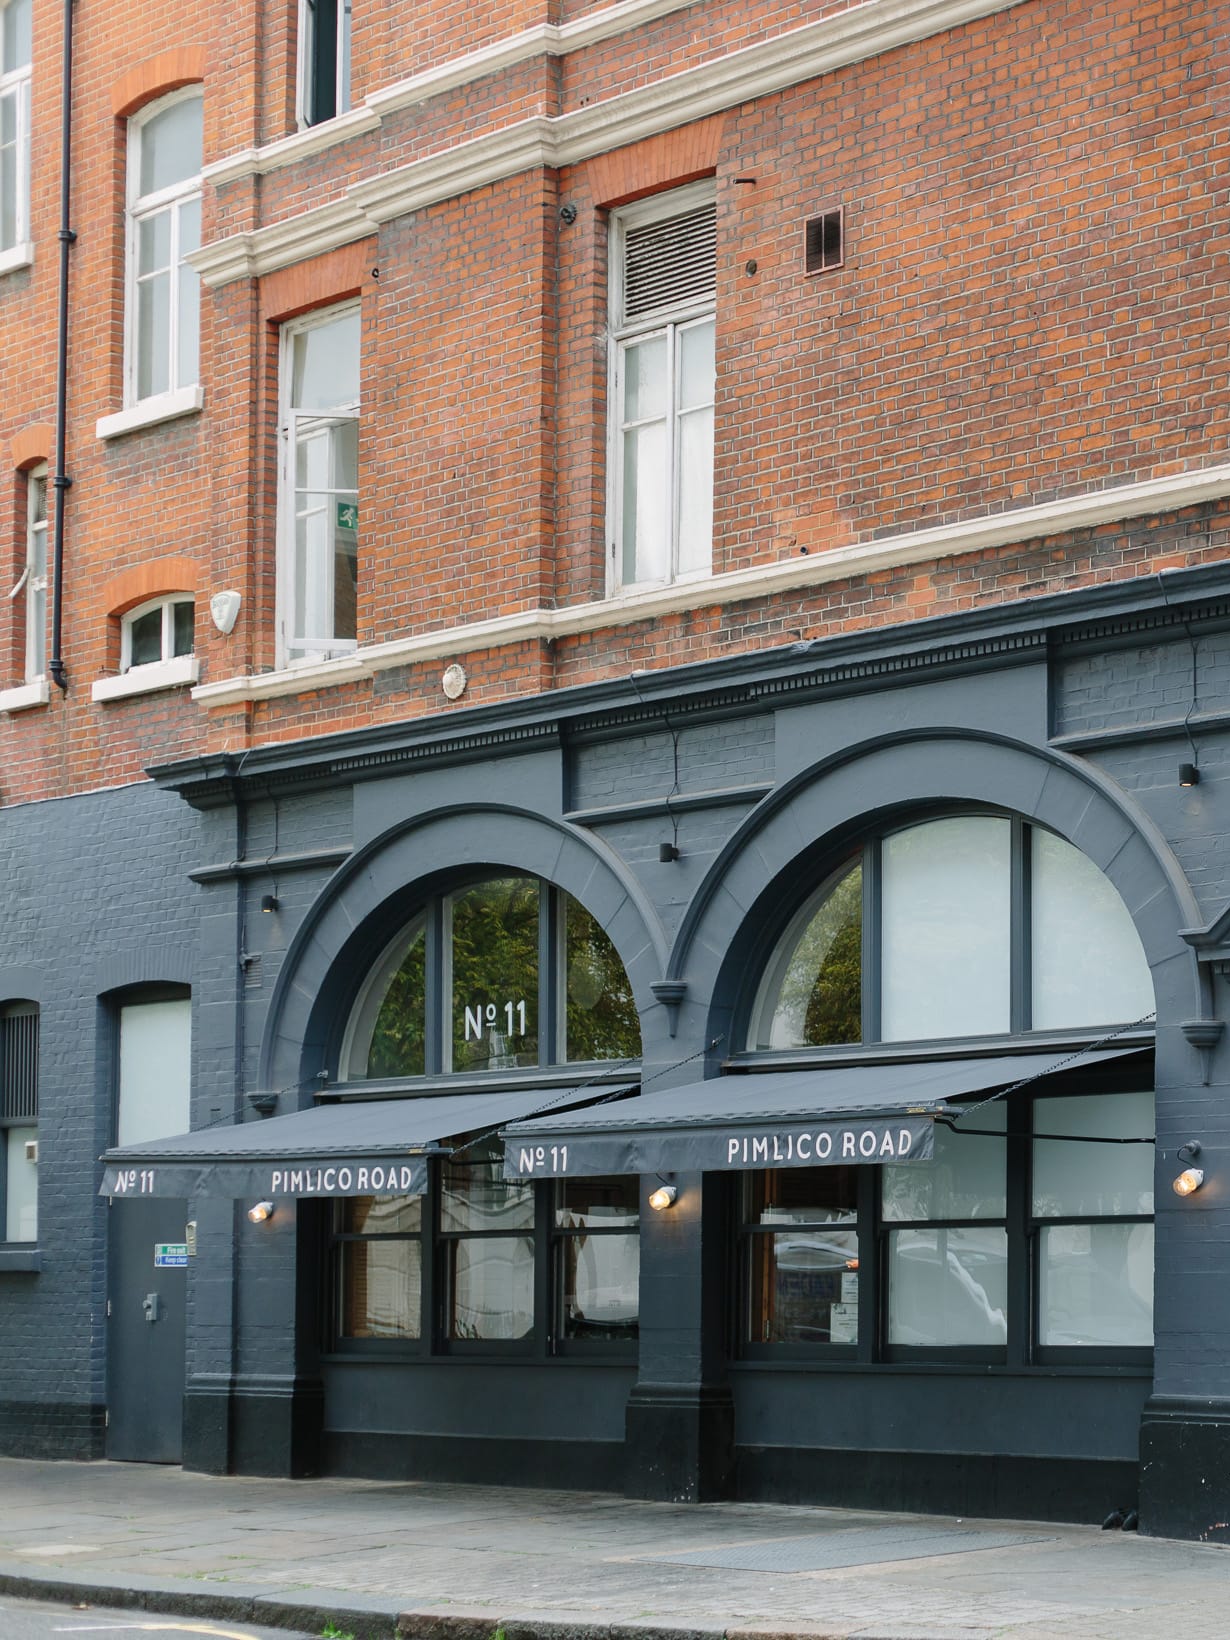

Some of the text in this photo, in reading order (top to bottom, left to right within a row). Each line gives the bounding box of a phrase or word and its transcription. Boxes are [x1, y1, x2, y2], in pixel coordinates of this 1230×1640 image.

[505, 1000, 526, 1037] 11
[551, 1146, 567, 1172] 11
[728, 1130, 912, 1163] PIMLICO ROAD
[140, 1170, 155, 1193] 11
[272, 1166, 412, 1193] PIMLICO ROAD
